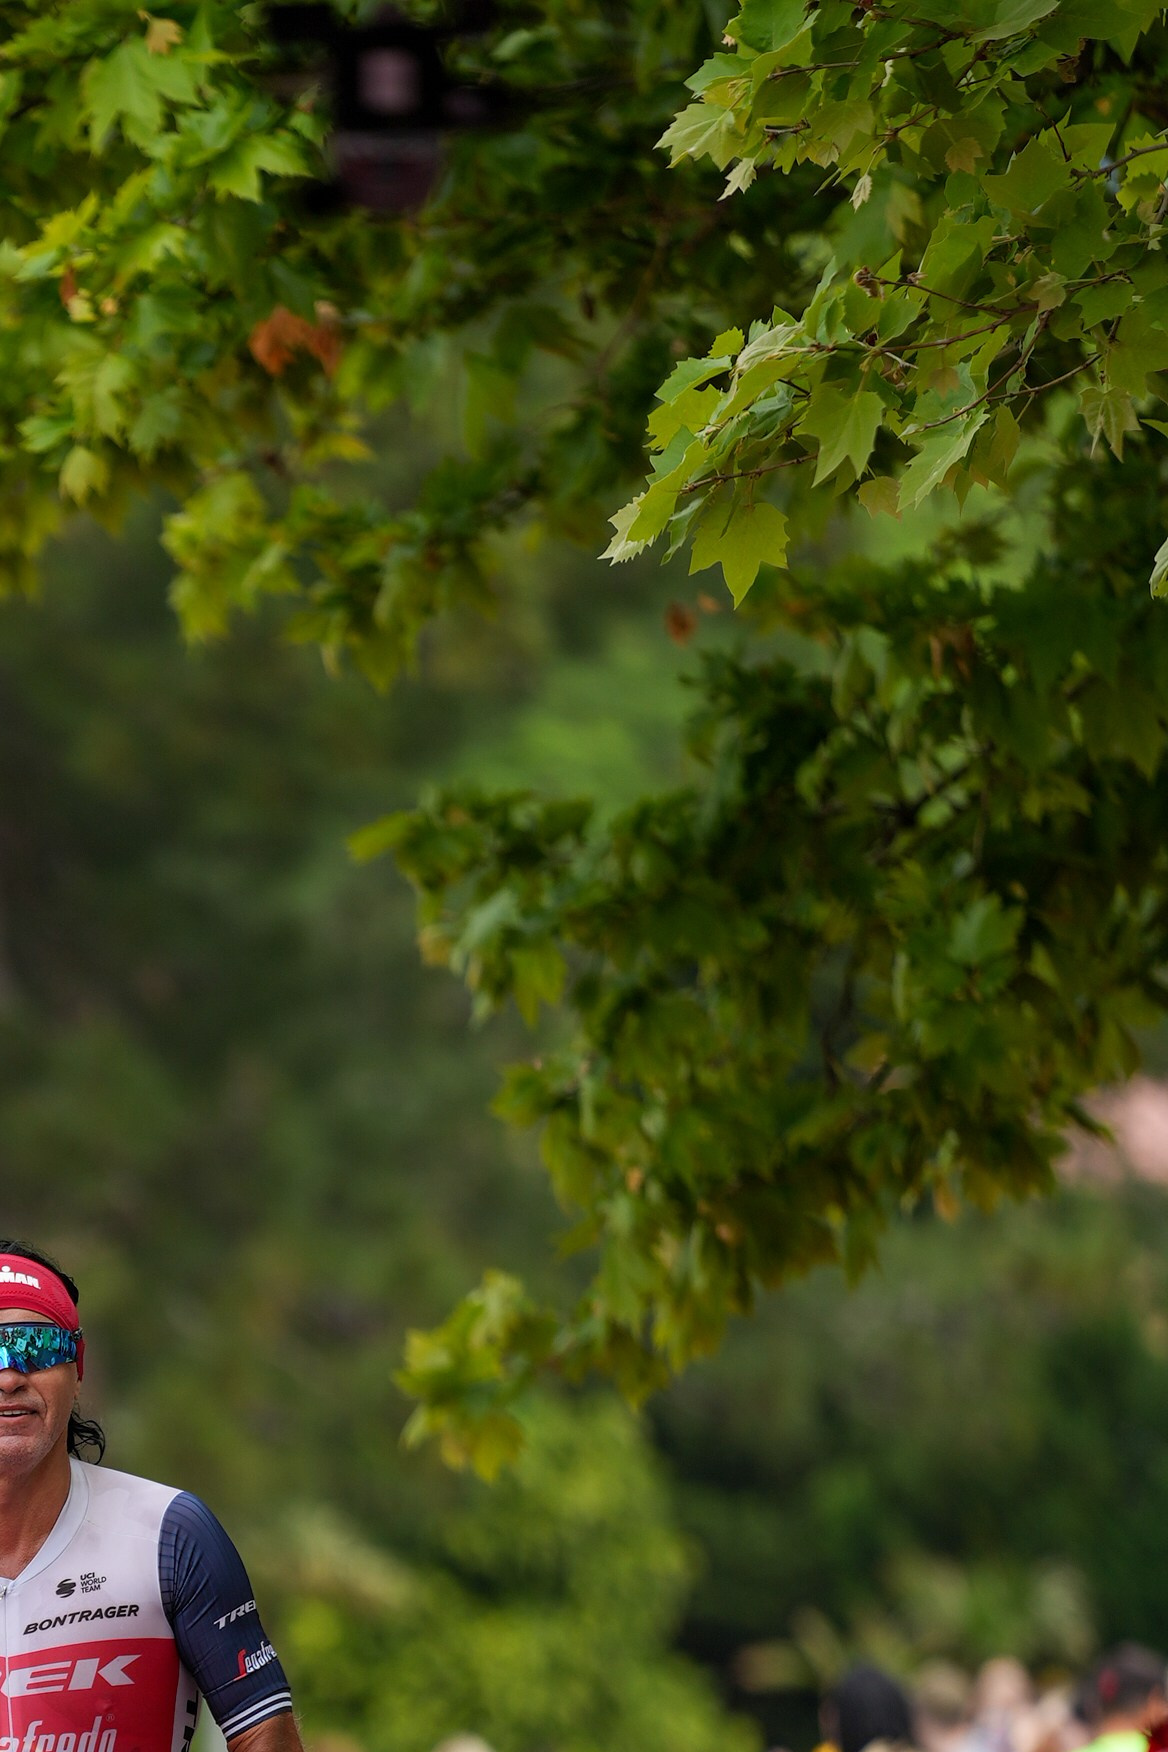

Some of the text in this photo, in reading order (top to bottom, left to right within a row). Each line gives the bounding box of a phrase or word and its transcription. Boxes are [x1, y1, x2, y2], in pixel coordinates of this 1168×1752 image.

[80, 1572, 95, 1581] UCI
[80, 1576, 107, 1587] WORLD
[81, 1584, 101, 1594] TEAM
[23, 1604, 140, 1635] BONTRAGER
[213, 1600, 256, 1629] TRE
